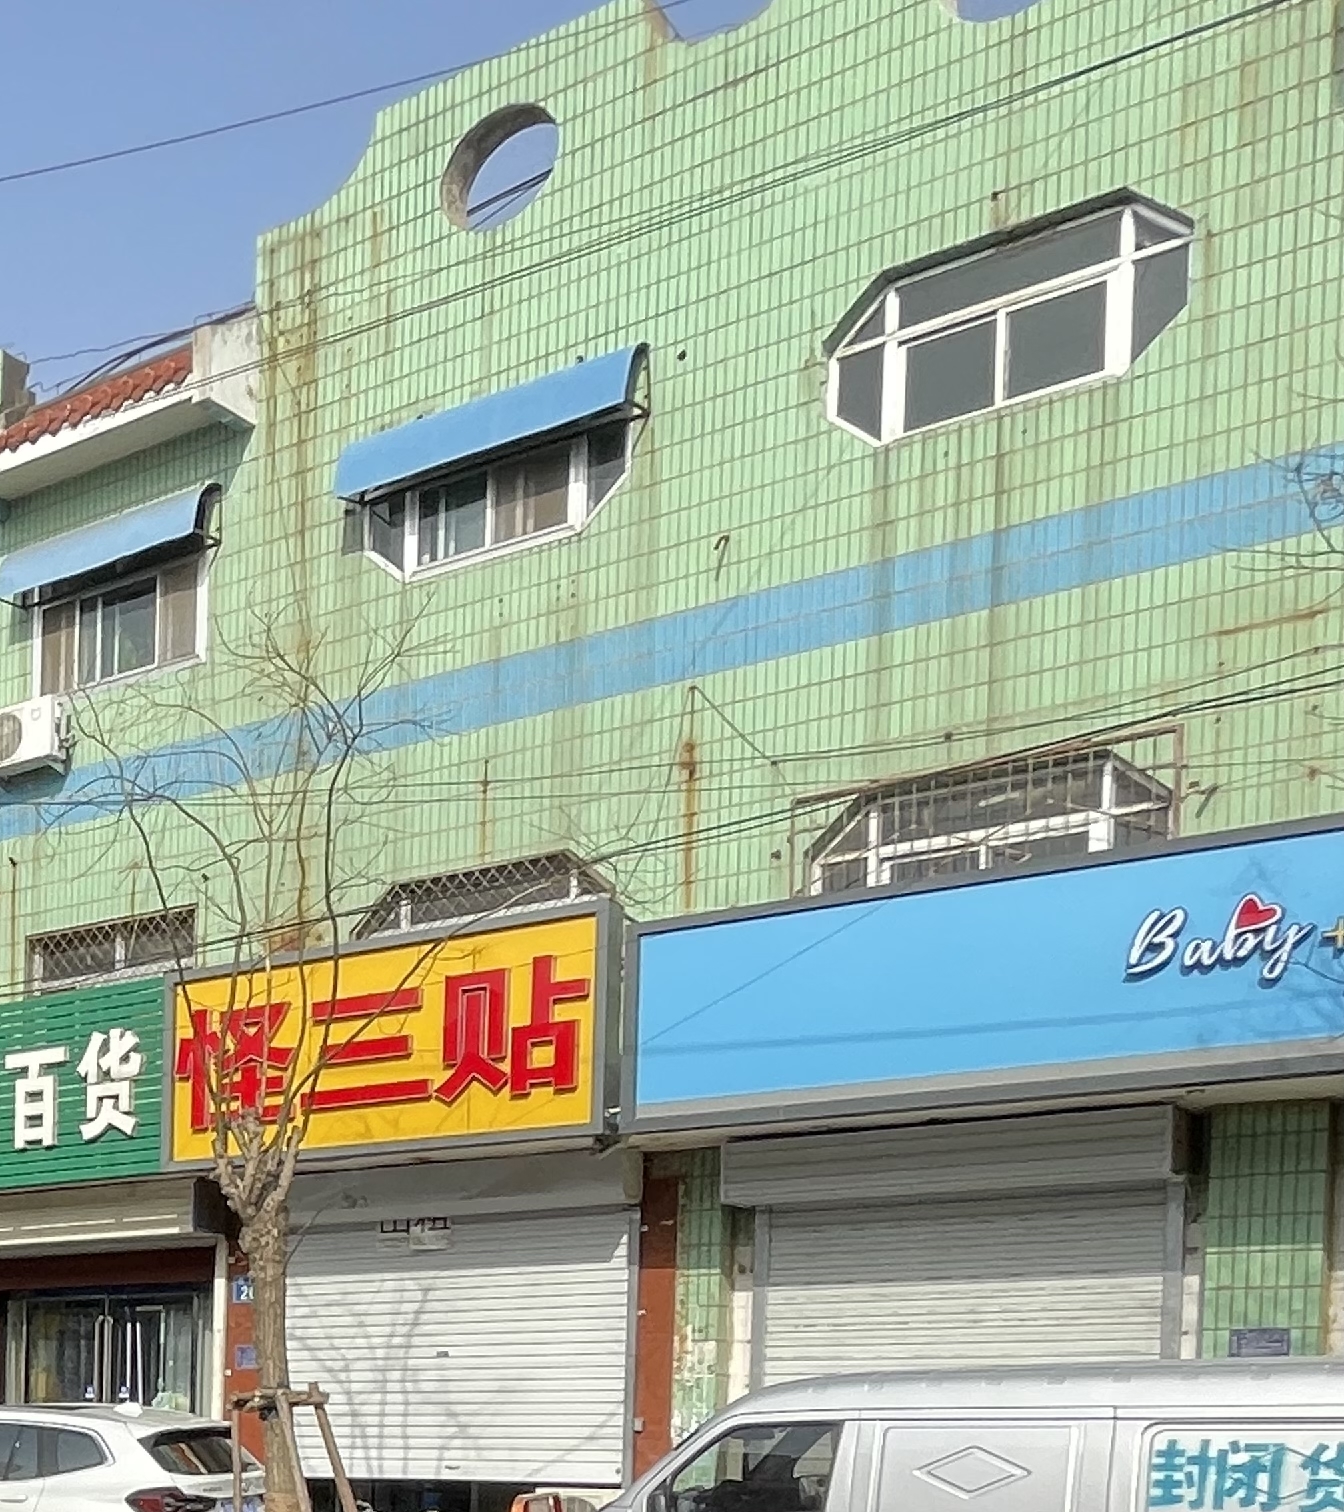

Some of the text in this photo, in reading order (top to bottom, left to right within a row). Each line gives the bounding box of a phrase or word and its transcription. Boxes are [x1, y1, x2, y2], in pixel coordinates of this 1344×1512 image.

[1124, 893, 1314, 982] Baby
[175, 955, 590, 1132] 怪三贴
